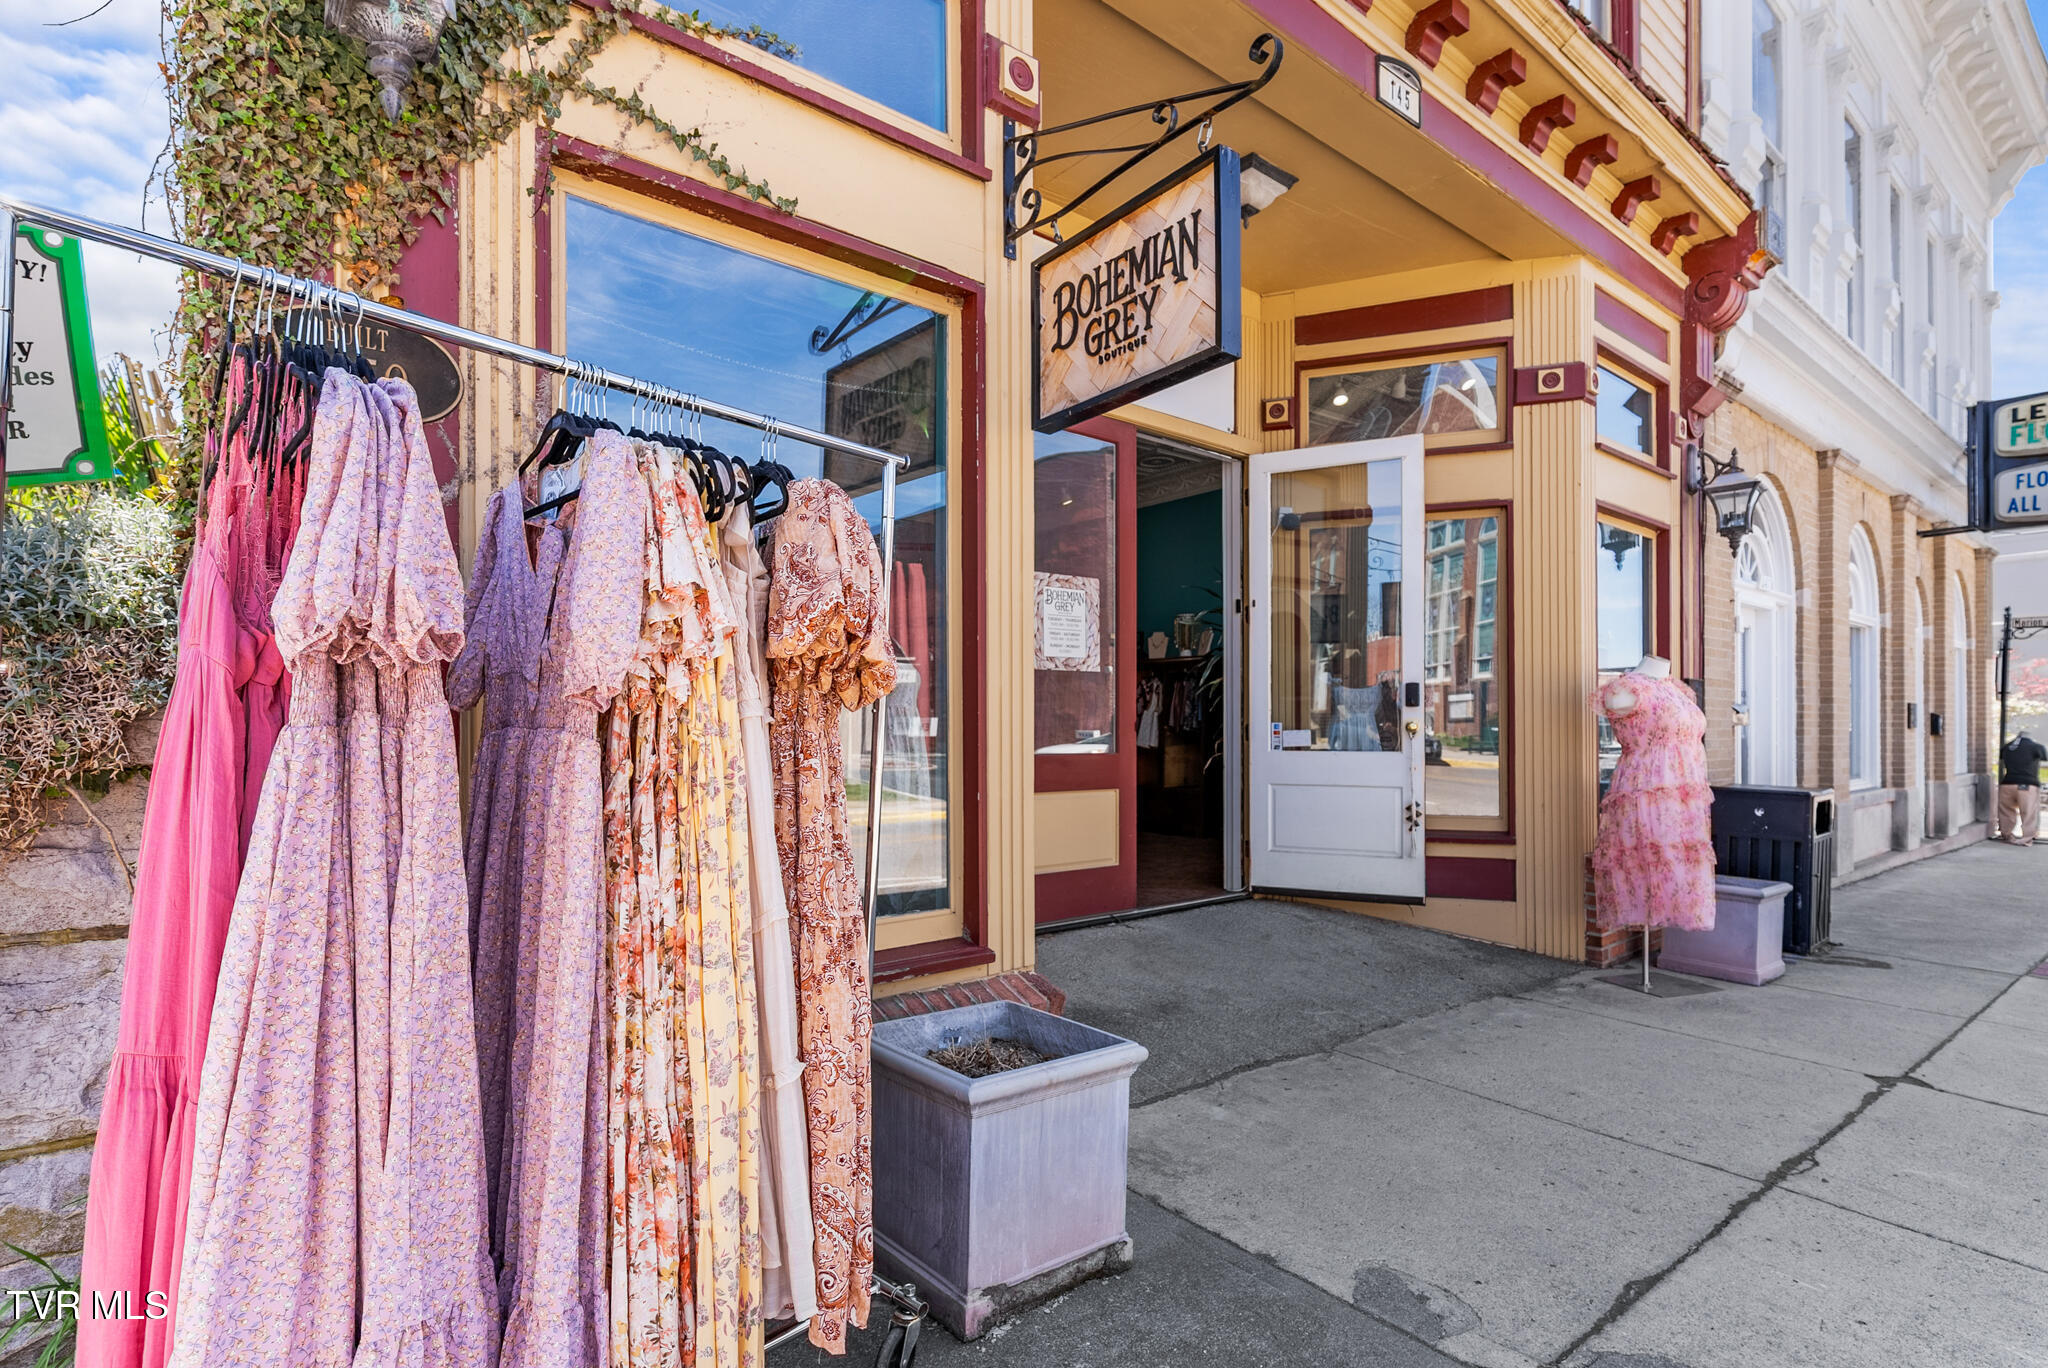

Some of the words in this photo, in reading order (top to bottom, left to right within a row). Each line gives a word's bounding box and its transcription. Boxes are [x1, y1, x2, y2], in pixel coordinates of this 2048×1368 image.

[1391, 80, 1410, 110] 145
[16, 259, 47, 283] Y!
[1051, 209, 1202, 352] BOHEMIAN
[1084, 284, 1160, 357] GREY
[326, 318, 389, 352] BUILT
[1098, 334, 1147, 365] BOUTIQUE
[2012, 403, 2047, 423] LE
[2010, 422, 2048, 446] FL
[2008, 495, 2041, 513] ALL
[1045, 588, 1085, 606] BOHEMIAN
[1054, 601, 1075, 612] GREY
